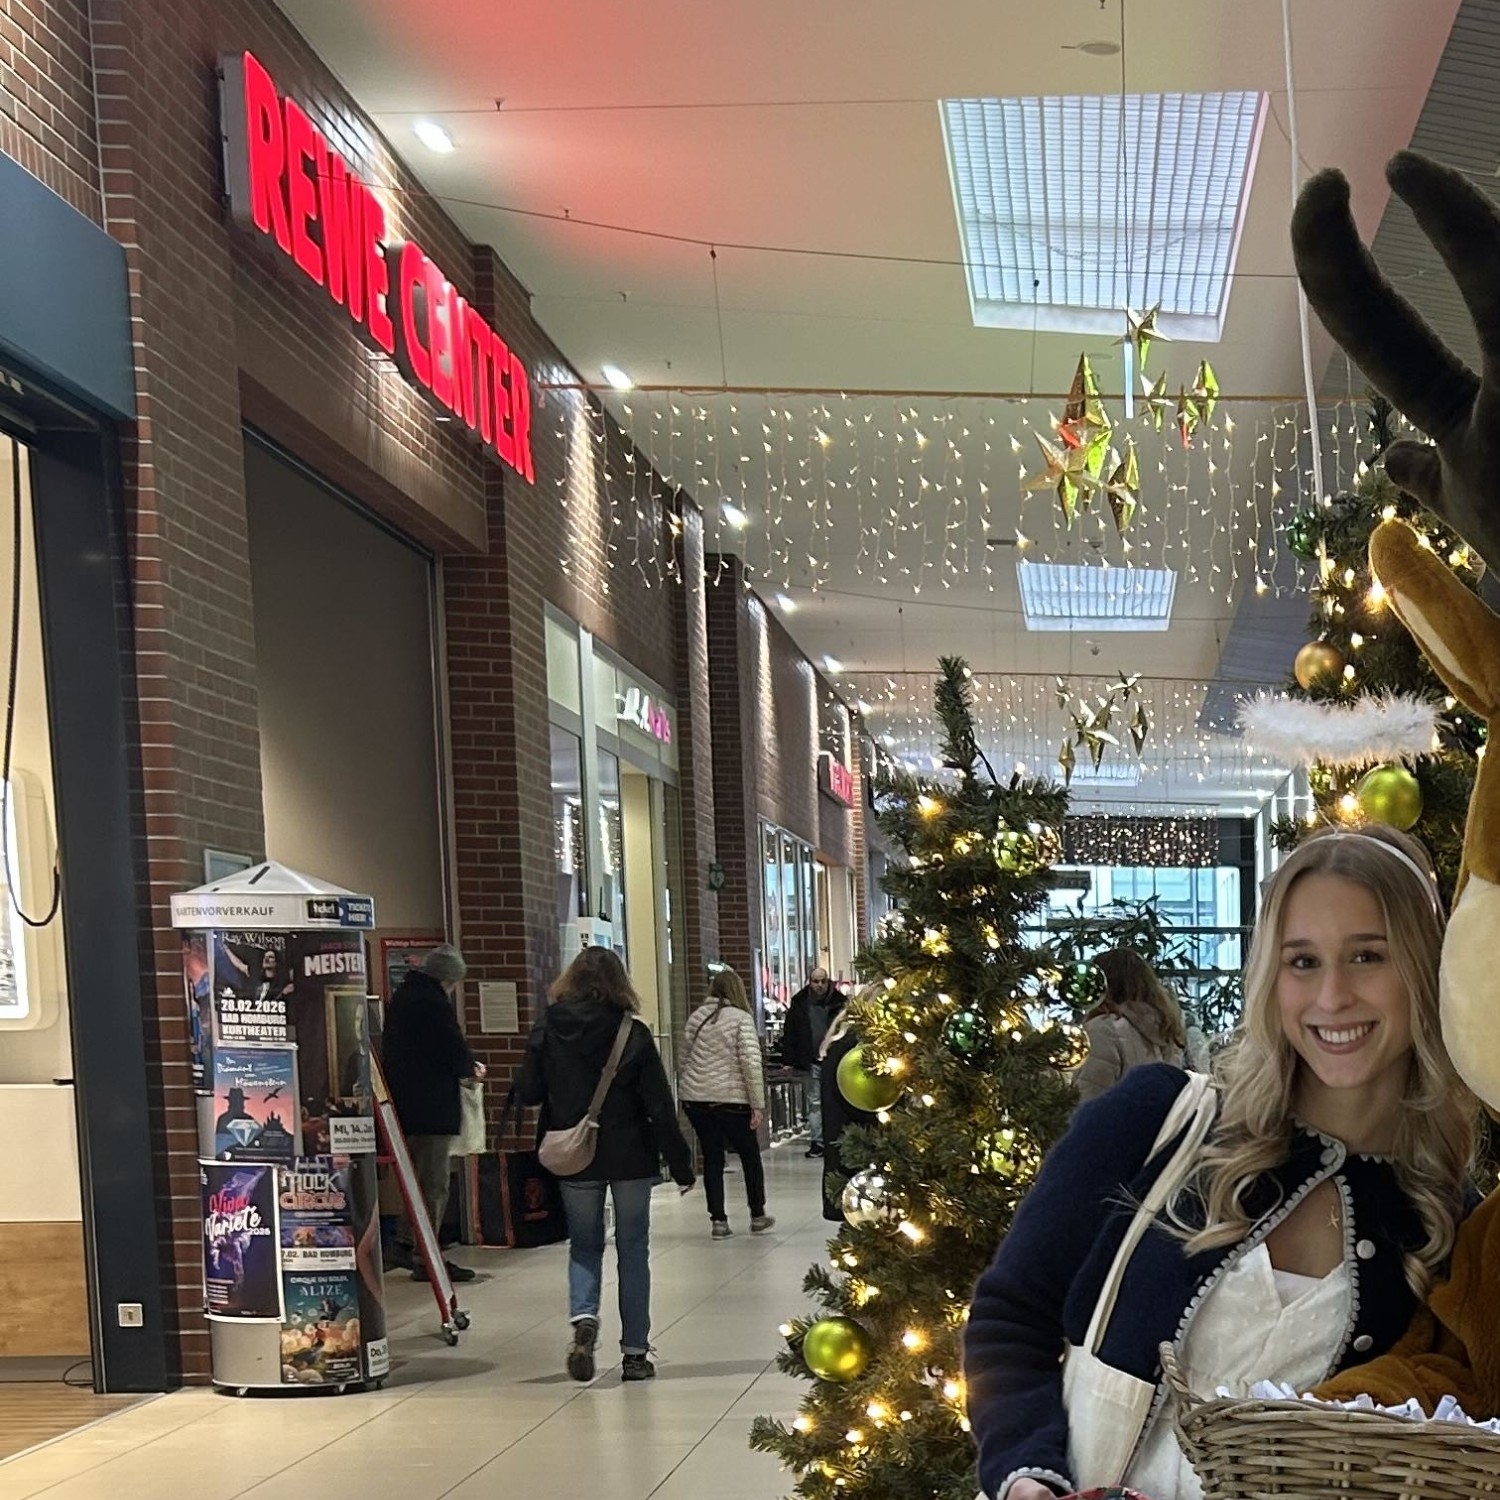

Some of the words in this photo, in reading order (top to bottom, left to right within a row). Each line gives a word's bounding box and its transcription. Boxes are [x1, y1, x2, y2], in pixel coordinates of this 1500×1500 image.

[244, 51, 395, 354] REWE
[401, 240, 535, 485] CENTER
[221, 999, 286, 1013] 28.02.2026
[221, 1012, 239, 1024] BAD
[240, 1013, 287, 1025] HOMBURG
[302, 1250, 318, 1258] BAD
